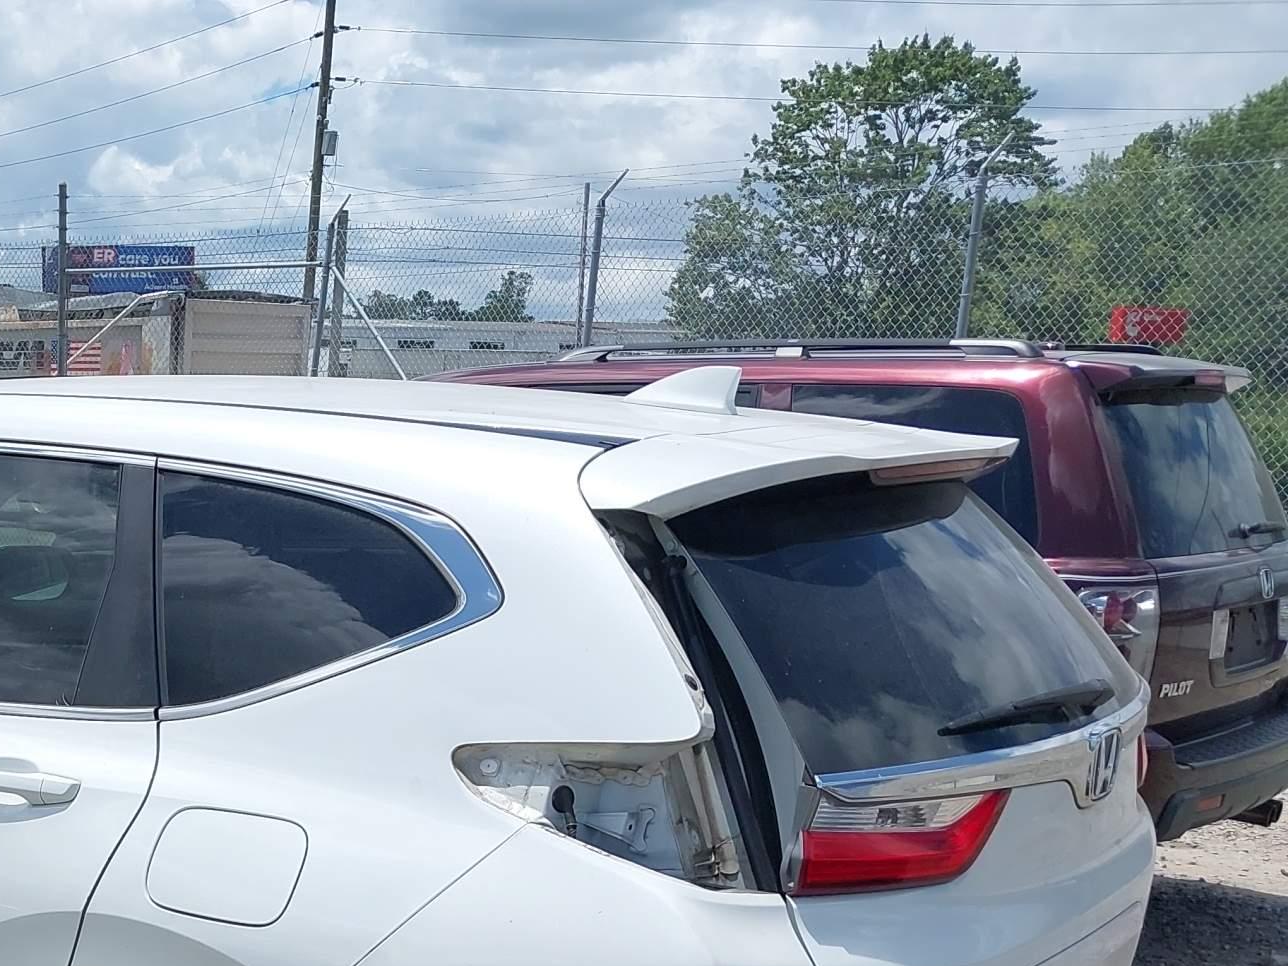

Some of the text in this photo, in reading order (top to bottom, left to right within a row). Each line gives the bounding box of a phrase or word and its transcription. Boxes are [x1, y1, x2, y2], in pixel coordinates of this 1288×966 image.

[93, 249, 179, 266] ER care you
[1159, 679, 1194, 698] PILOT
